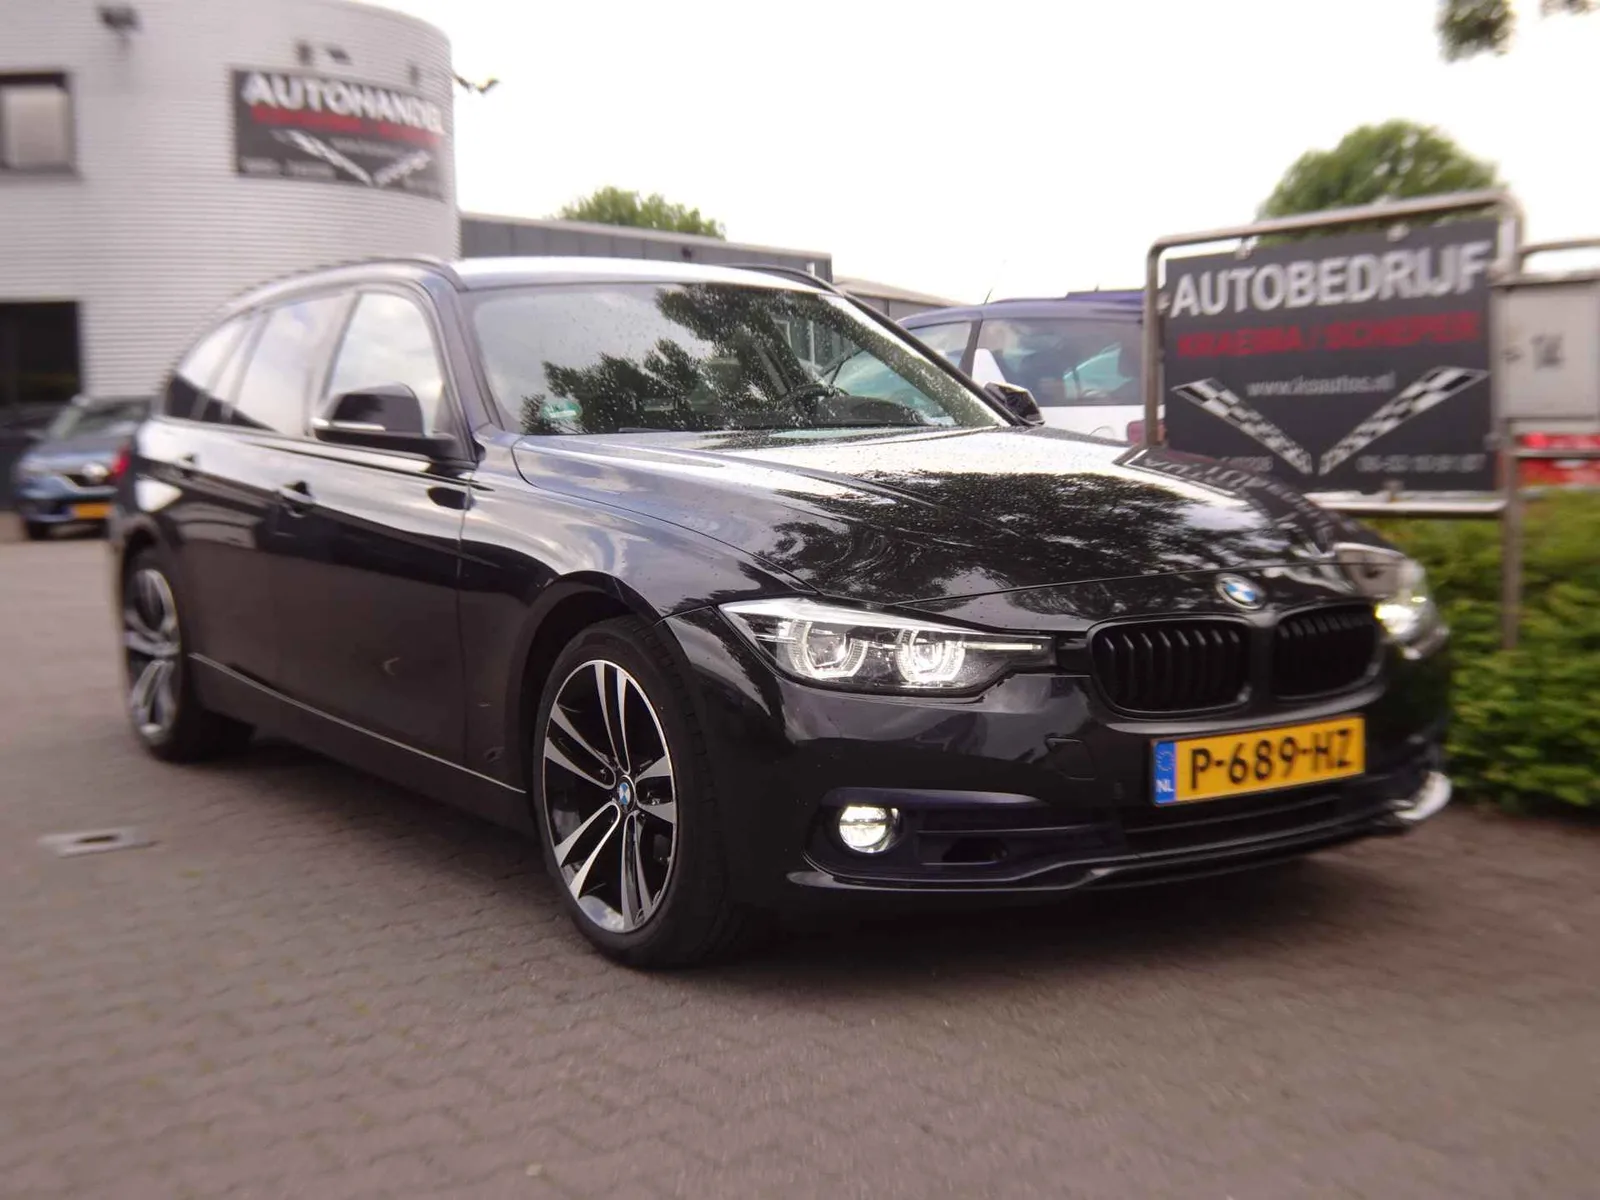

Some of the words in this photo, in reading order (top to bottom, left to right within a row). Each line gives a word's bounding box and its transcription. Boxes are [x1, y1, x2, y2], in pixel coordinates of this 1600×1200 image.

[1170, 241, 1492, 318] AUTOBEDRIJF
[1156, 779, 1174, 793] NL
[1191, 728, 1351, 791] P-689-HZ
